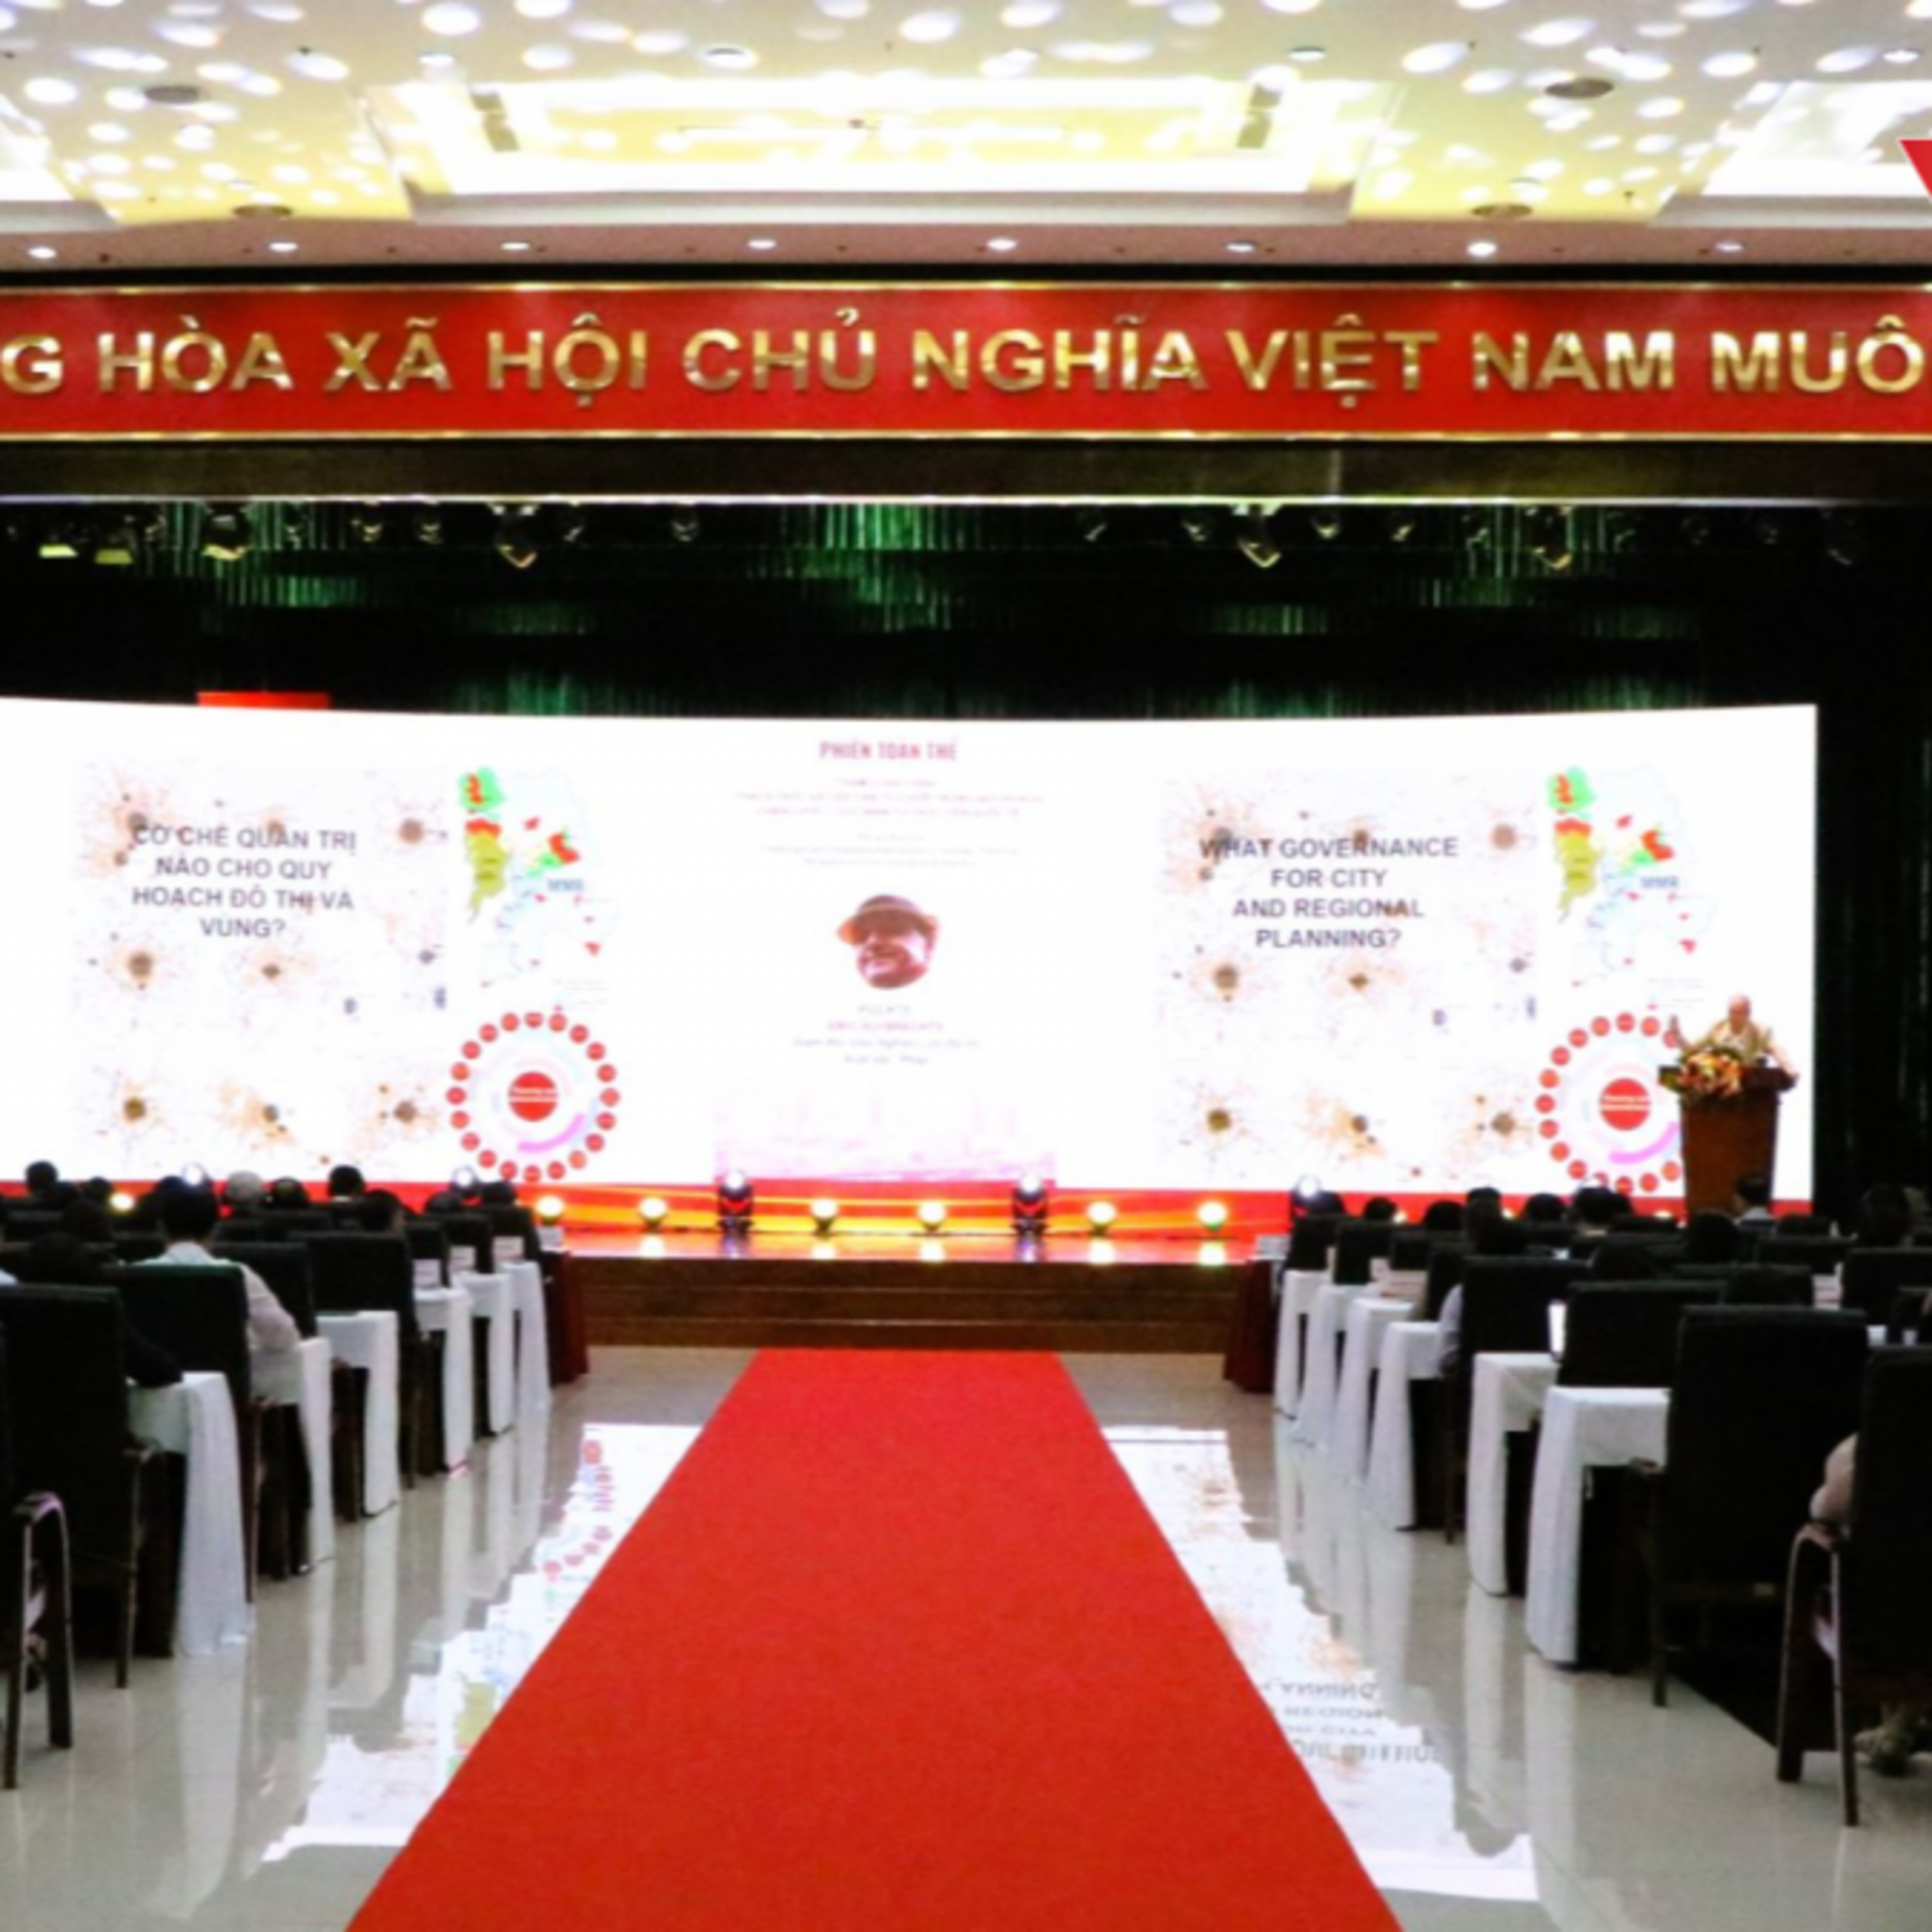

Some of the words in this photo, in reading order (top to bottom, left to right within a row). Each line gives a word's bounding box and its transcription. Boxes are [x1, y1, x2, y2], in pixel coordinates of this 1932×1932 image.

[0, 335, 63, 394] G
[97, 314, 294, 393] HÒA
[324, 316, 453, 392] XÃ
[488, 312, 648, 408] HỘI
[683, 307, 877, 392] CHỦ
[913, 313, 1207, 392] NGHĨA
[1225, 313, 1439, 409] VIỆT
[1473, 331, 1674, 392] NAM
[1711, 314, 1926, 393] MUÔ
[1200, 838, 1273, 858] WHAT
[1279, 838, 1459, 858] GOVERNANCE
[217, 857, 272, 878] CHO
[278, 858, 331, 879] QUY
[1271, 869, 1322, 887] FOR
[1331, 869, 1388, 887] CITY
[1233, 899, 1285, 918] AND
[1293, 899, 1425, 918] REGIONAL
[1255, 929, 1401, 948] PLANNING?
